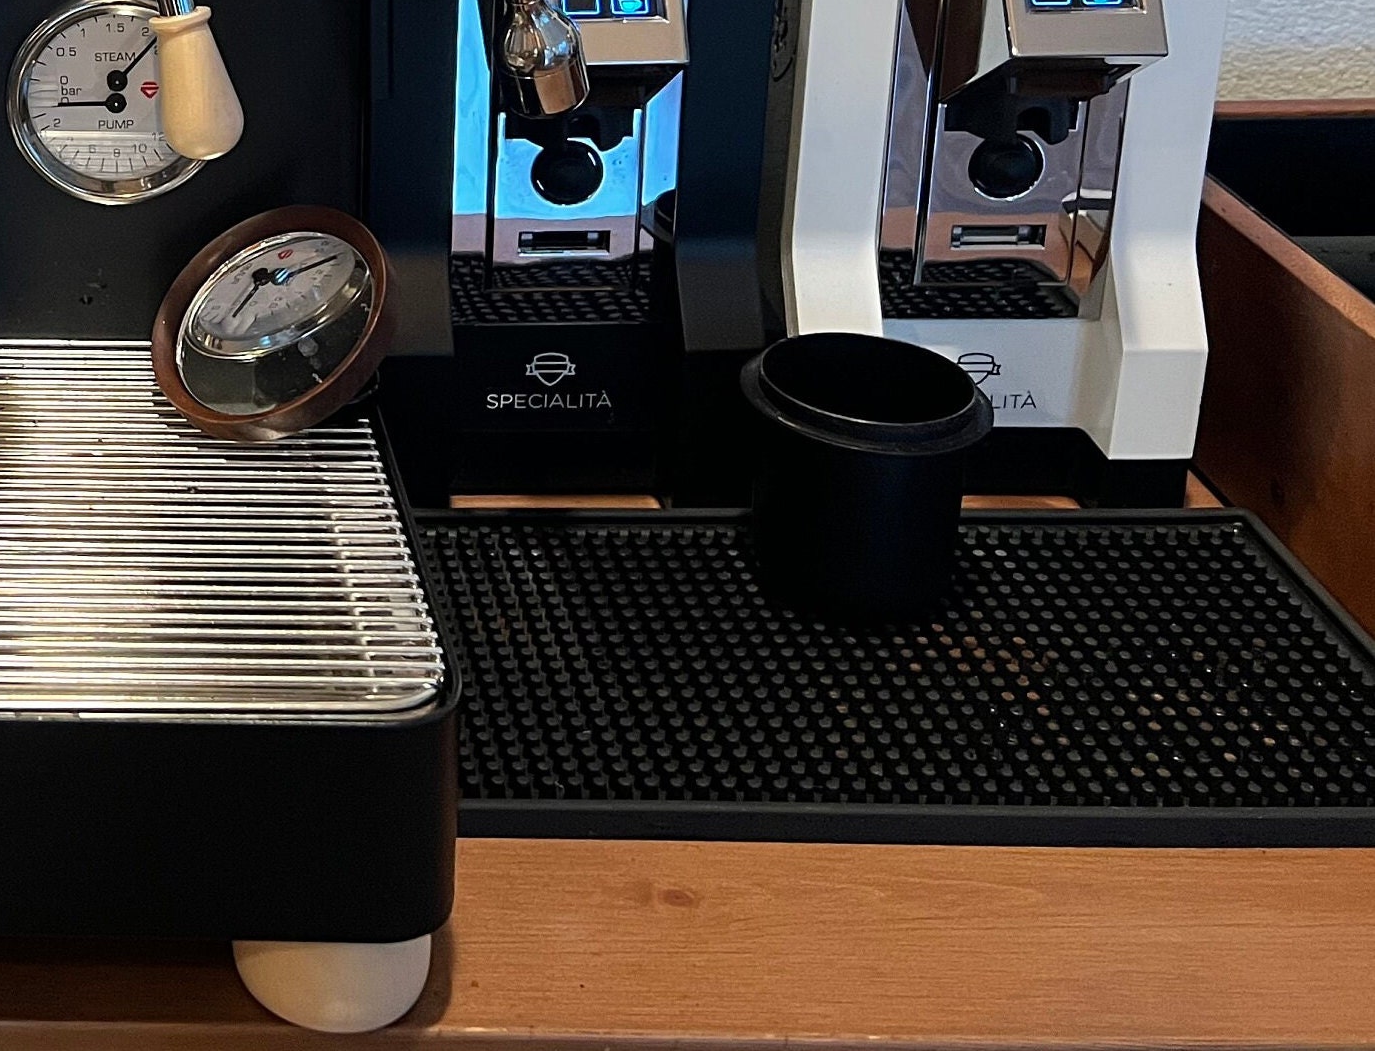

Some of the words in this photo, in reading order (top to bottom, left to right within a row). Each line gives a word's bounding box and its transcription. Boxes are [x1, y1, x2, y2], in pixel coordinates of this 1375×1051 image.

[105, 23, 125, 33] 1.5
[141, 27, 150, 37] 2
[56, 47, 77, 57] 0.5
[94, 52, 136, 62] STEAM
[59, 76, 69, 85] 0
[61, 86, 82, 96] bar
[53, 119, 61, 128] 2
[98, 120, 134, 130] PUMP
[113, 148, 121, 158] 8
[132, 143, 148, 154] 10
[485, 390, 613, 410] SPECIALITÀ
[989, 390, 1037, 410] LITÀ
